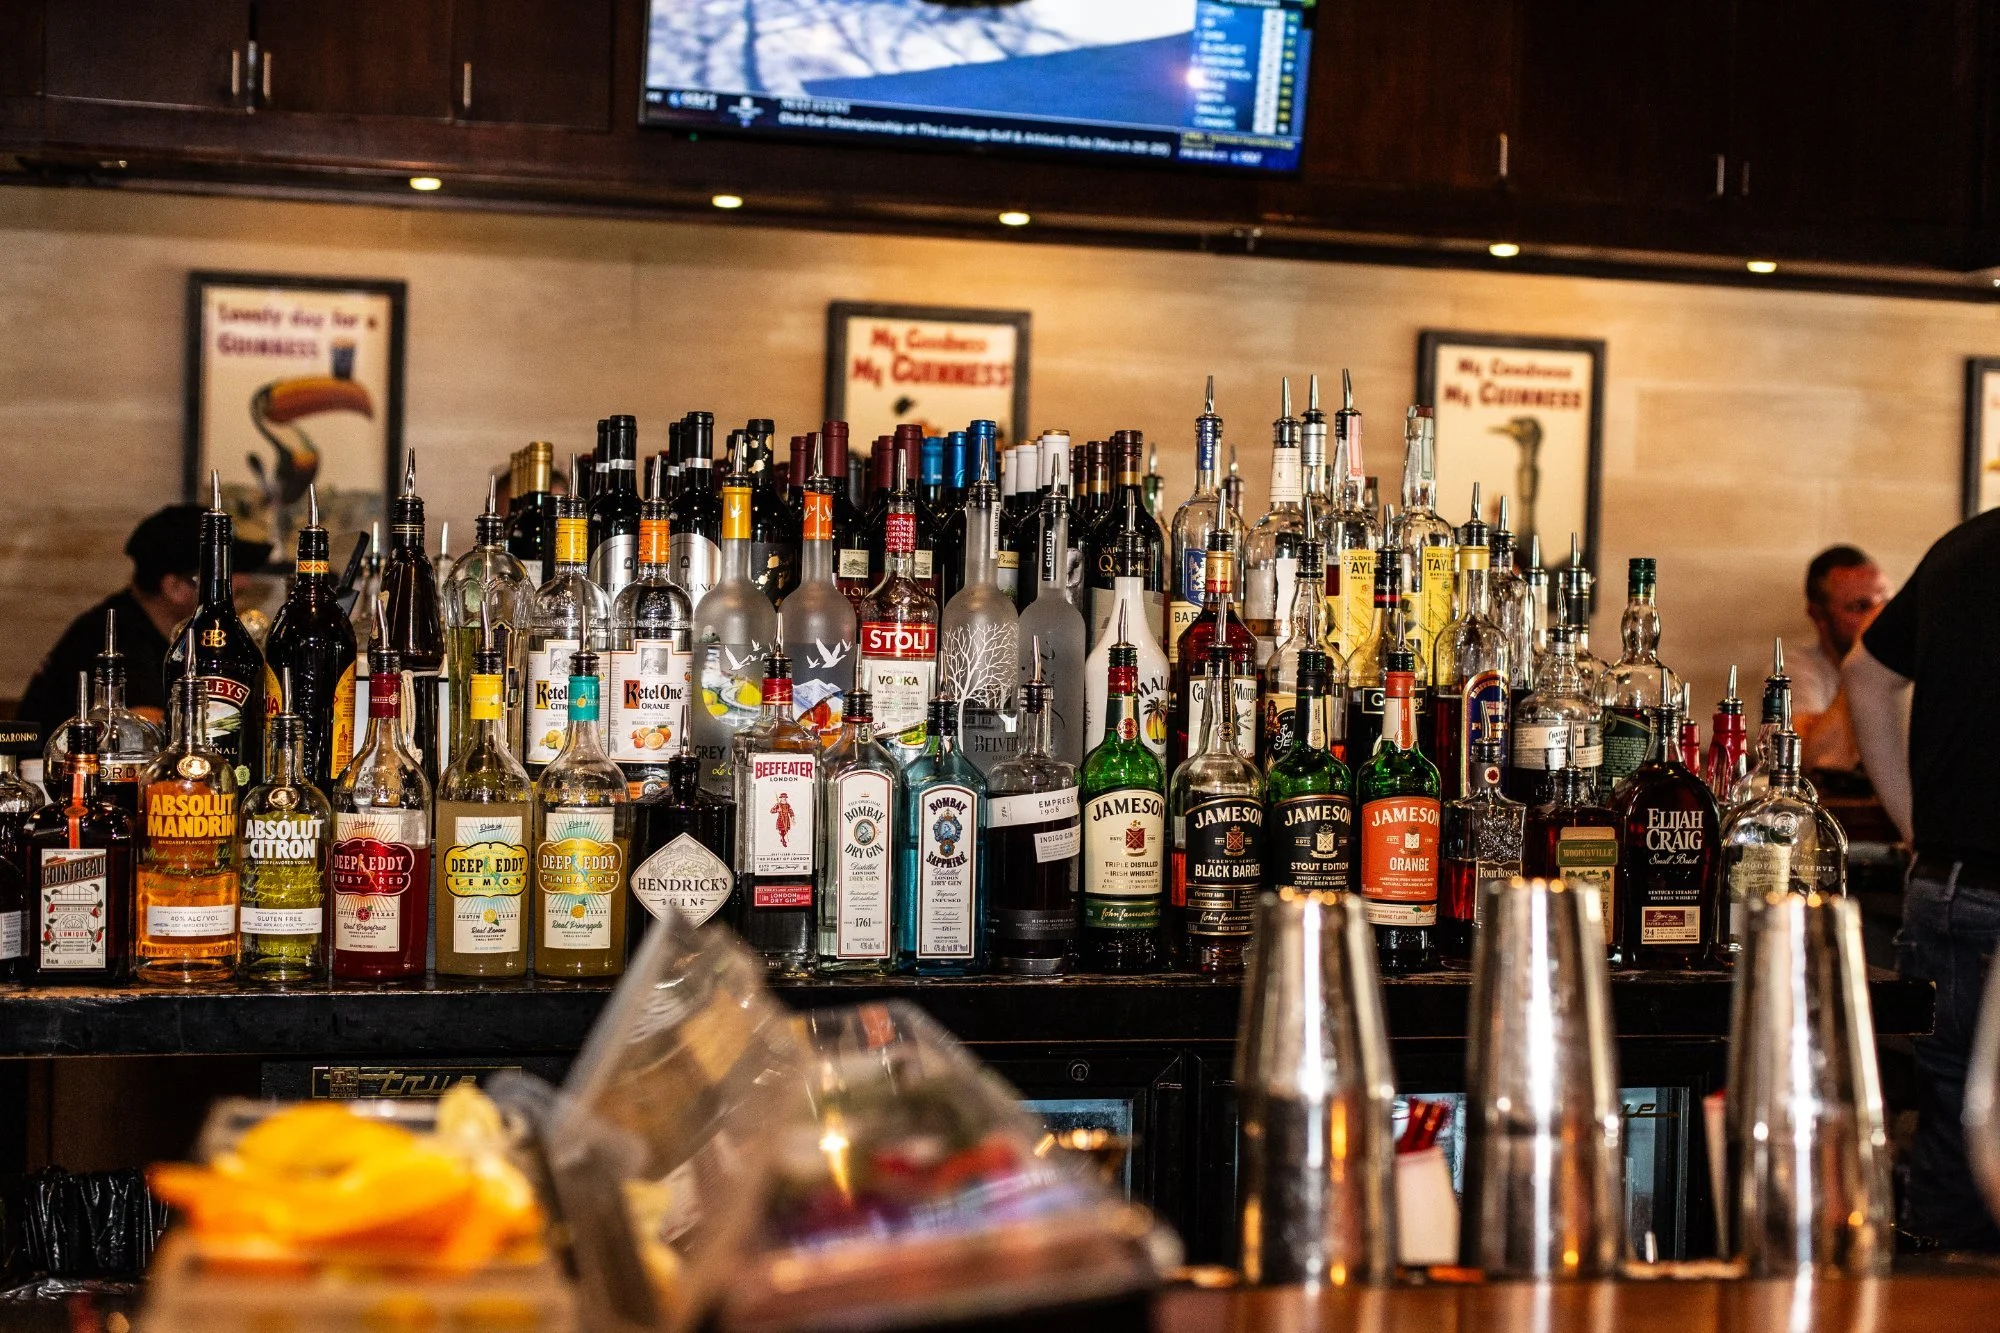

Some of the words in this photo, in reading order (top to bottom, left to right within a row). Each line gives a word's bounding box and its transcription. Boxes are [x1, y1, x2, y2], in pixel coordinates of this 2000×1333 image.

[870, 629, 930, 650] STOLI
[878, 675, 919, 686] VODKA
[205, 681, 245, 700] LEYS
[626, 682, 660, 706] Ketel
[660, 684, 682, 700] One
[641, 702, 670, 710] ORANJE
[755, 762, 813, 780] BEEFEATER
[150, 794, 235, 816] ABSOLUT
[928, 797, 968, 816] BOMBAY
[1038, 796, 1074, 808] EMPRESS
[844, 806, 886, 824] BOMBAY
[1040, 807, 1060, 816] 1908
[1092, 798, 1164, 822] JAMESON
[1194, 806, 1263, 829] JAMESON
[1284, 806, 1352, 826] JAMESON
[1372, 807, 1440, 828] JAMESON
[147, 815, 236, 838] MANDRIN
[1646, 808, 1704, 832] ELIJAH
[245, 820, 324, 840] ABSOLUT
[1040, 833, 1063, 844] INDIGO
[1064, 832, 1074, 841] GIN
[1646, 829, 1703, 852] CRAIG
[250, 840, 316, 858] CITRON
[844, 842, 865, 858] DRY
[866, 842, 885, 858] GIN
[1562, 849, 1614, 857] WOODINVILLE
[334, 854, 358, 870] DEEP
[369, 856, 405, 870] EDDY
[452, 858, 484, 872] DEEP
[496, 857, 525, 872] EDDY
[542, 854, 572, 870] DEEP
[584, 855, 616, 870] EDDY
[926, 851, 968, 869] SAPPHIRE
[1290, 862, 1320, 871] STOUT
[1322, 862, 1349, 870] EDITION
[1390, 858, 1430, 872] ORANGE
[1649, 853, 1672, 865] Small
[1672, 853, 1700, 865] Batch
[44, 856, 106, 886] COINTREAU
[1195, 864, 1230, 878] BLACK
[1232, 864, 1260, 878] BARREL
[1480, 867, 1496, 878] Four
[1498, 867, 1520, 879] Roses
[1791, 864, 1834, 872] RESERVE
[335, 876, 362, 884] RUBY
[378, 876, 404, 884] RED
[456, 877, 520, 886] LEMON
[544, 876, 615, 884] PINEAPPLE
[638, 878, 728, 892] HENDRICK'S
[669, 898, 698, 906] GIN
[487, 926, 507, 934] Lemon
[552, 920, 568, 928] Real
[570, 920, 603, 931] Pineapple
[856, 918, 872, 928] 1761
[1644, 928, 1655, 936] 94
